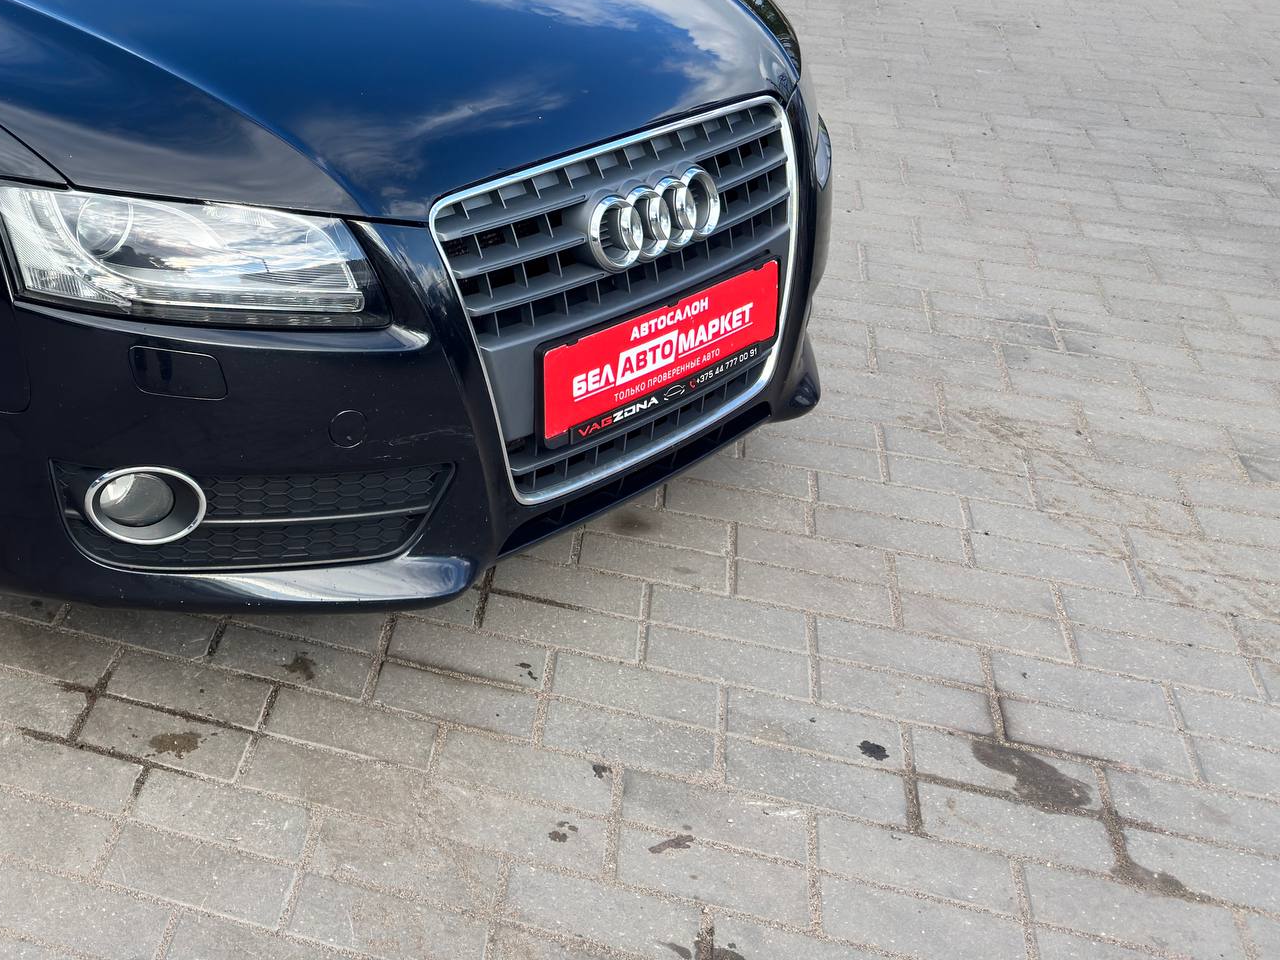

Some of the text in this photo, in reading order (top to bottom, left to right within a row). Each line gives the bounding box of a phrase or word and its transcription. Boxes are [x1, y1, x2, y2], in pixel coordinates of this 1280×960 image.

[630, 296, 709, 341] АВТОСАЛОН
[614, 348, 720, 402] ТОЛЬКО ПРОВЕРЕННЫЕ АВТО
[696, 371, 714, 384] +375
[714, 366, 724, 375] 44
[725, 357, 738, 370] 777
[739, 352, 749, 362] 00
